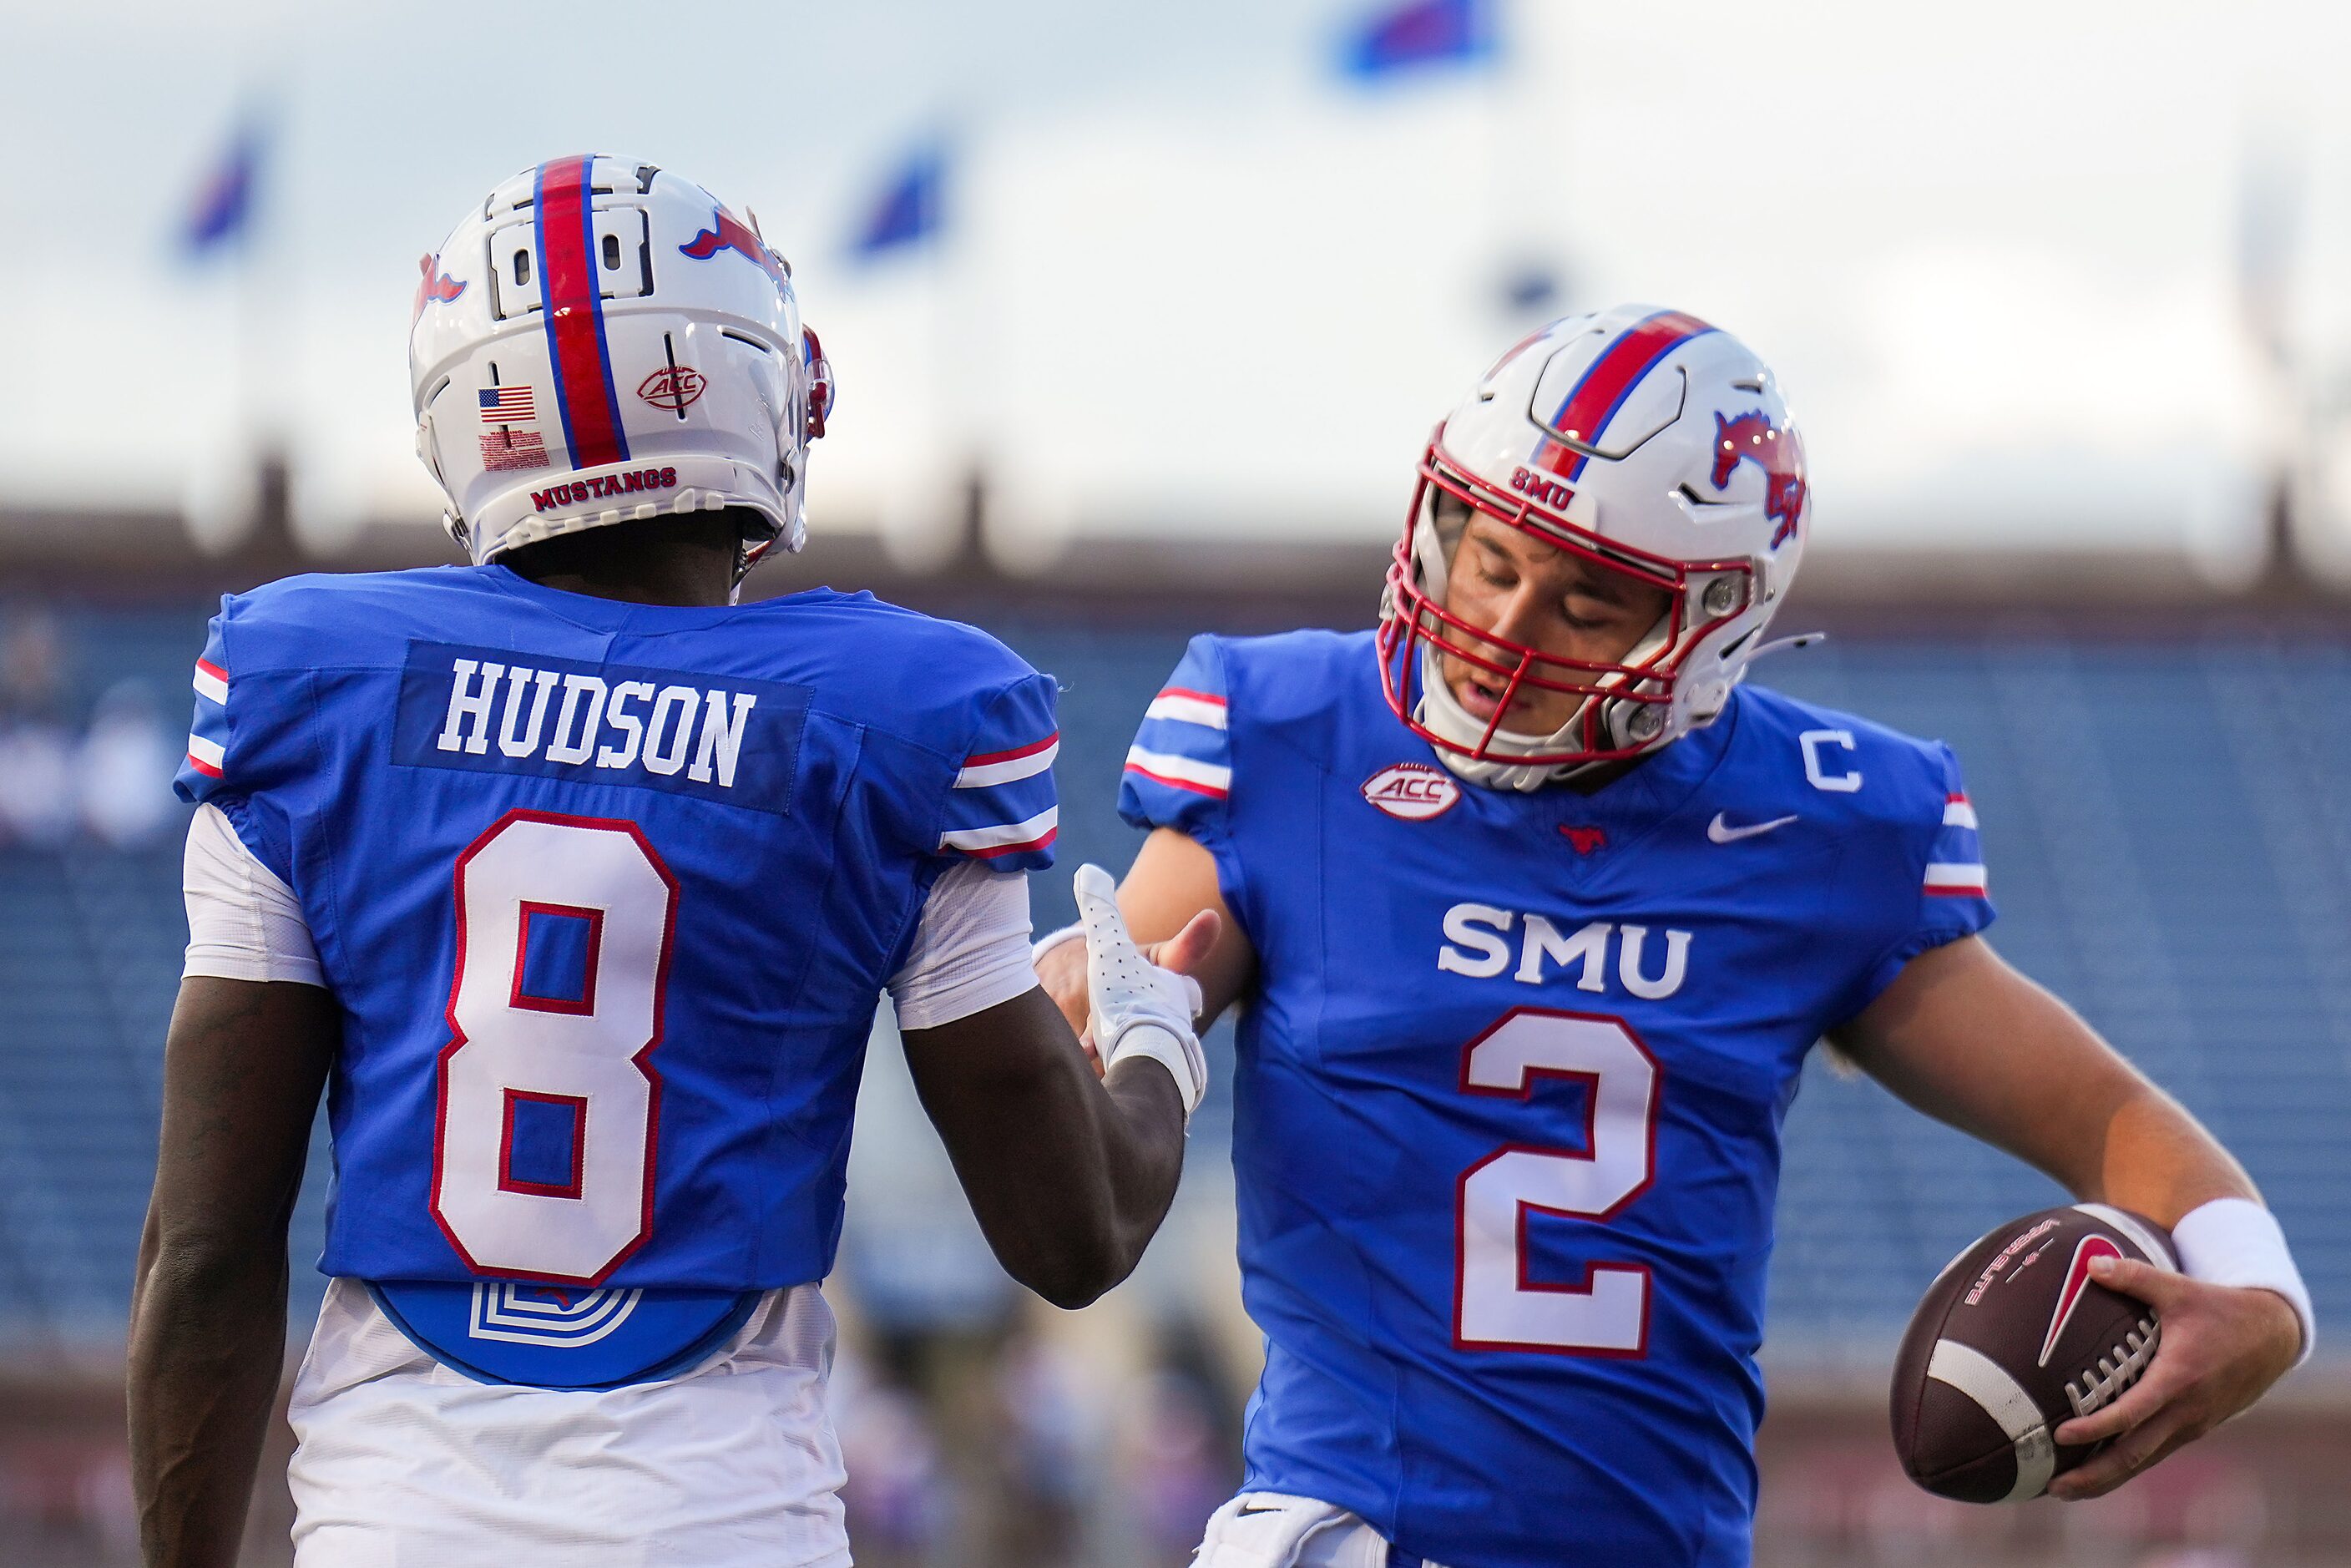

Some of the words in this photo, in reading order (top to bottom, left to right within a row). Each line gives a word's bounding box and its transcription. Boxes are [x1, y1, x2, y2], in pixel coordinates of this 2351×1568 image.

[648, 373, 698, 396] ACC
[529, 466, 677, 513] MUSTANGS
[1509, 466, 1575, 512] SMU
[437, 658, 757, 788] HUDSON
[1378, 777, 1447, 799] ACC
[1798, 729, 1863, 793] C
[1437, 902, 1693, 1000] SMU
[429, 807, 680, 1287] 8
[1453, 1005, 1663, 1359] 2
[1964, 1252, 2010, 1306] ELITE
